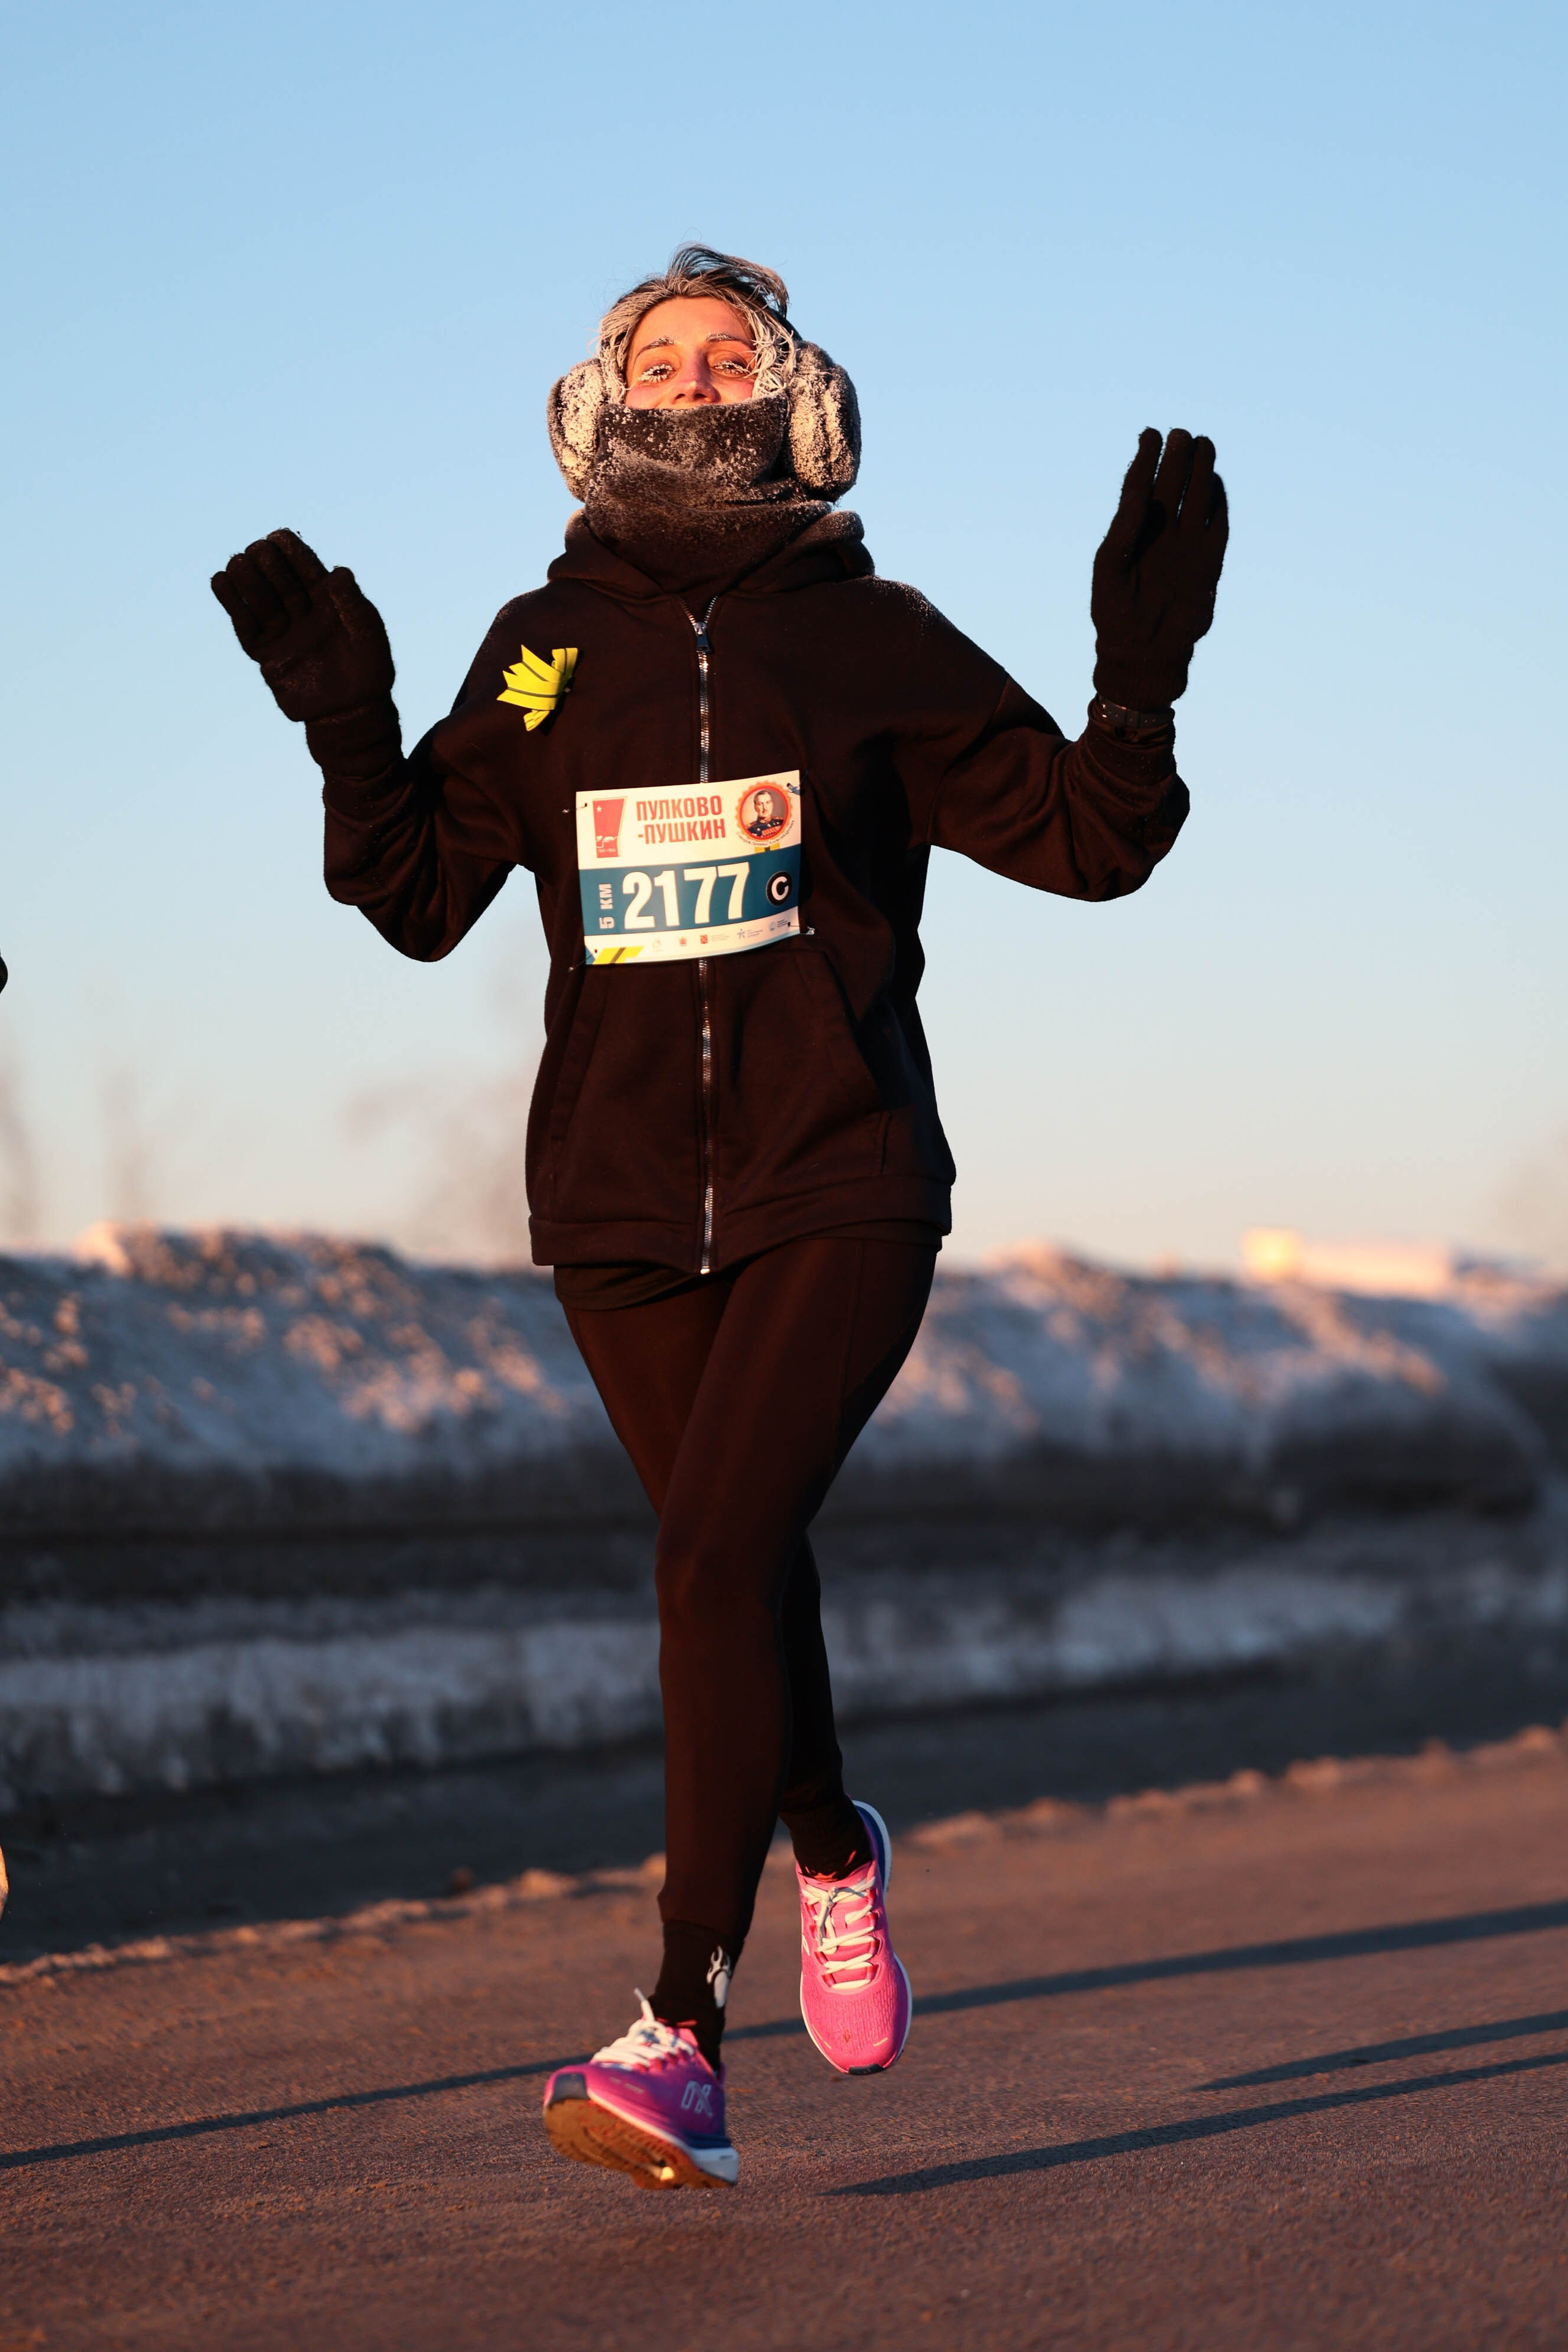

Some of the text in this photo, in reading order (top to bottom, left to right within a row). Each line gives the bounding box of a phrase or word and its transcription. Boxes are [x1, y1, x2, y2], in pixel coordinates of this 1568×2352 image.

[636, 795, 722, 821] ПУЛКОВО
[638, 818, 726, 845] -ПУШКИН
[622, 861, 750, 930] 2177
[599, 916, 615, 929] 5
